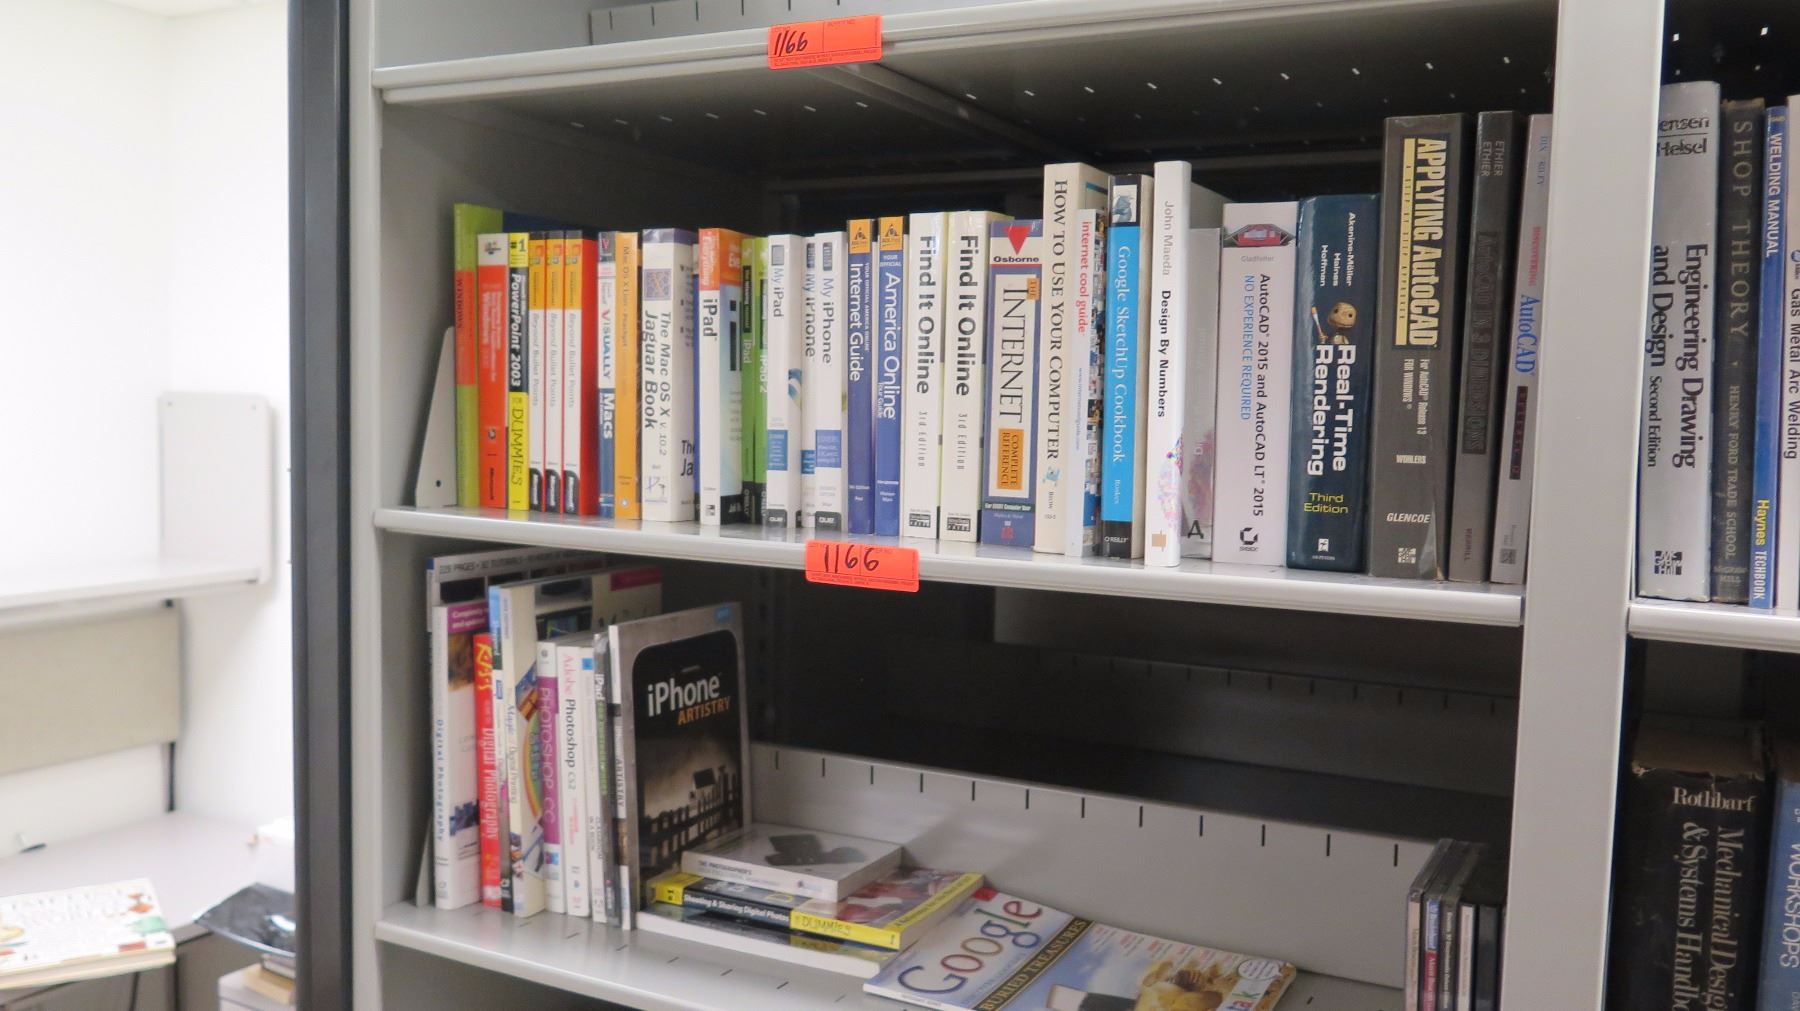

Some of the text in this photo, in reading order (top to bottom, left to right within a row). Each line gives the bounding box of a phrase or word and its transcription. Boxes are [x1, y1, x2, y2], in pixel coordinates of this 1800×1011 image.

[774, 29, 808, 57] 1166
[1480, 141, 1492, 177] ETHIER
[1494, 140, 1505, 176] ETHIER
[1765, 133, 1783, 257] WELDING MANUAL
[509, 242, 527, 253] #1
[1408, 138, 1447, 347] APPLYING AutoCAD
[1729, 120, 1752, 337] SHOP THEORY
[992, 255, 1039, 264] Osborne
[1075, 220, 1092, 334] internet cool guide
[1319, 244, 1329, 287] Hoffman
[1332, 253, 1341, 287] Haines
[703, 298, 718, 338] iPad
[772, 267, 785, 318] My iPad
[849, 262, 863, 328] Internet
[1157, 200, 1175, 418] John Maeda Design By Numbers
[510, 272, 522, 387] PowerPoint 2003
[530, 312, 541, 348] Beyond
[549, 312, 560, 348] Beyond
[566, 312, 577, 348] Beyond
[601, 308, 611, 379] VISUALLY
[660, 310, 672, 338] The
[821, 277, 835, 364] My iPhone
[884, 272, 901, 419] America Online
[1046, 180, 1068, 460] HOW TO USE YOUR COMPUTER
[1515, 293, 1541, 374] AutoCAD
[530, 349, 541, 377] Bullet
[549, 349, 560, 377] Bullet
[566, 349, 577, 377] Bullet
[641, 309, 659, 430] Jaguar Book
[659, 343, 672, 376] Mac
[743, 338, 752, 364] iPad
[759, 354, 770, 379] iPad
[849, 330, 864, 382] Guide
[916, 235, 935, 467] Find It Online 3rd Edition
[955, 235, 979, 470] Find It Online 3rd Edition
[998, 287, 1030, 423] INTERNET
[1111, 245, 1131, 463] Google SketchUp Cookbook
[1240, 275, 1254, 421] NO EXPERIENCE REQUIRED
[1404, 358, 1414, 371] FOR
[1420, 358, 1430, 370] For
[1643, 244, 1676, 468] and Design Second Edition
[1672, 243, 1708, 469] Engineering Drawing
[530, 379, 541, 408] Points
[549, 379, 560, 408] Points
[566, 379, 577, 408] Points
[604, 392, 615, 440] Macs
[659, 381, 671, 402] OS
[659, 406, 671, 418] X
[1307, 344, 1334, 476] Rendering
[1333, 344, 1356, 472] Real-Time
[511, 406, 525, 486] DUMMIES
[1252, 340, 1269, 517] 2015 and AutoCAD 2015
[1783, 400, 1800, 460] Welding
[1000, 432, 1011, 487] REFERENCE
[1009, 434, 1020, 486] COMPLETE
[1724, 384, 1741, 560] HENRY FORD TRADE SCHOOL
[1303, 503, 1349, 514] Edition
[1309, 492, 1344, 502] Third
[1386, 512, 1430, 524] GLENCOE
[1187, 520, 1204, 539] A
[1752, 499, 1770, 600] Haynes TECHBOOK
[824, 545, 879, 574] 1166
[595, 673, 605, 700] iPad
[647, 674, 722, 717] iPhone
[677, 696, 730, 725] ARTISTRY
[564, 653, 578, 790] Adobe Photoshop CS2
[435, 718, 446, 843] Digital Photography
[540, 687, 556, 824] PHOTOSHOP CC
[482, 727, 501, 841] Digital Photography
[615, 758, 625, 808] ARTISTRY
[1672, 786, 1758, 812] Rothbart
[1673, 821, 1709, 928] & Systems
[800, 915, 850, 936] DUMMIES
[1702, 826, 1745, 1011] Mechanical Desig
[1780, 842, 1800, 968] WORKSHOPS
[896, 900, 1043, 995] Google
[981, 969, 1029, 1010] BURIED
[1026, 919, 1086, 976] TREASURES
